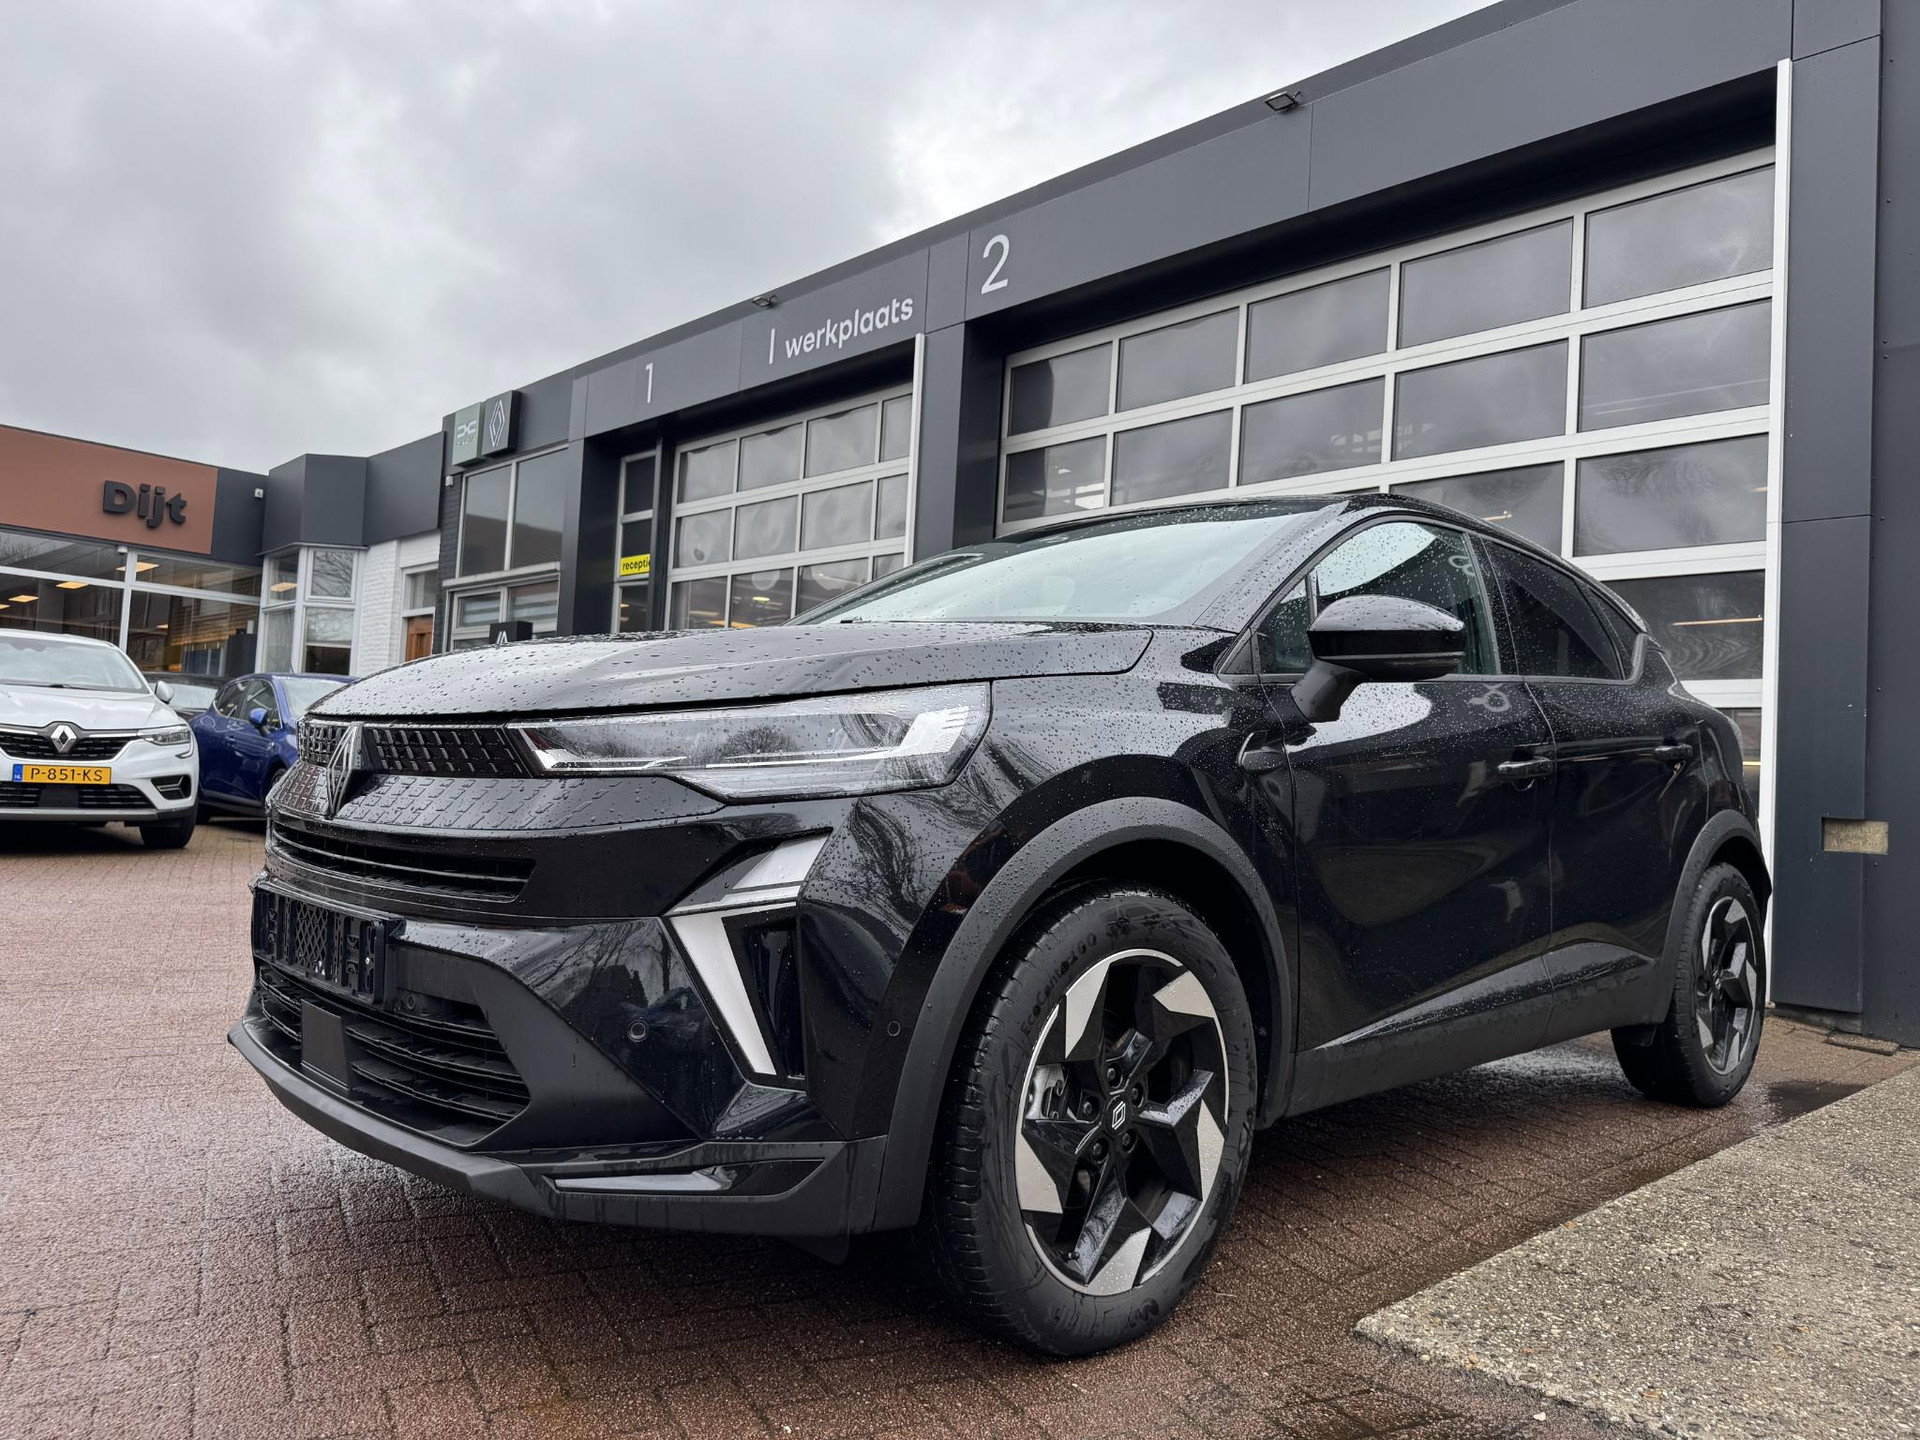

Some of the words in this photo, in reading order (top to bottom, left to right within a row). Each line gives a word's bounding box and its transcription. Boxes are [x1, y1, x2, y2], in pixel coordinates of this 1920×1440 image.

[981, 234, 1010, 295] 2
[785, 298, 914, 358] werkplaats
[645, 363, 653, 404] 1
[103, 480, 187, 529] Dijt
[31, 768, 103, 781] P-851-KS
